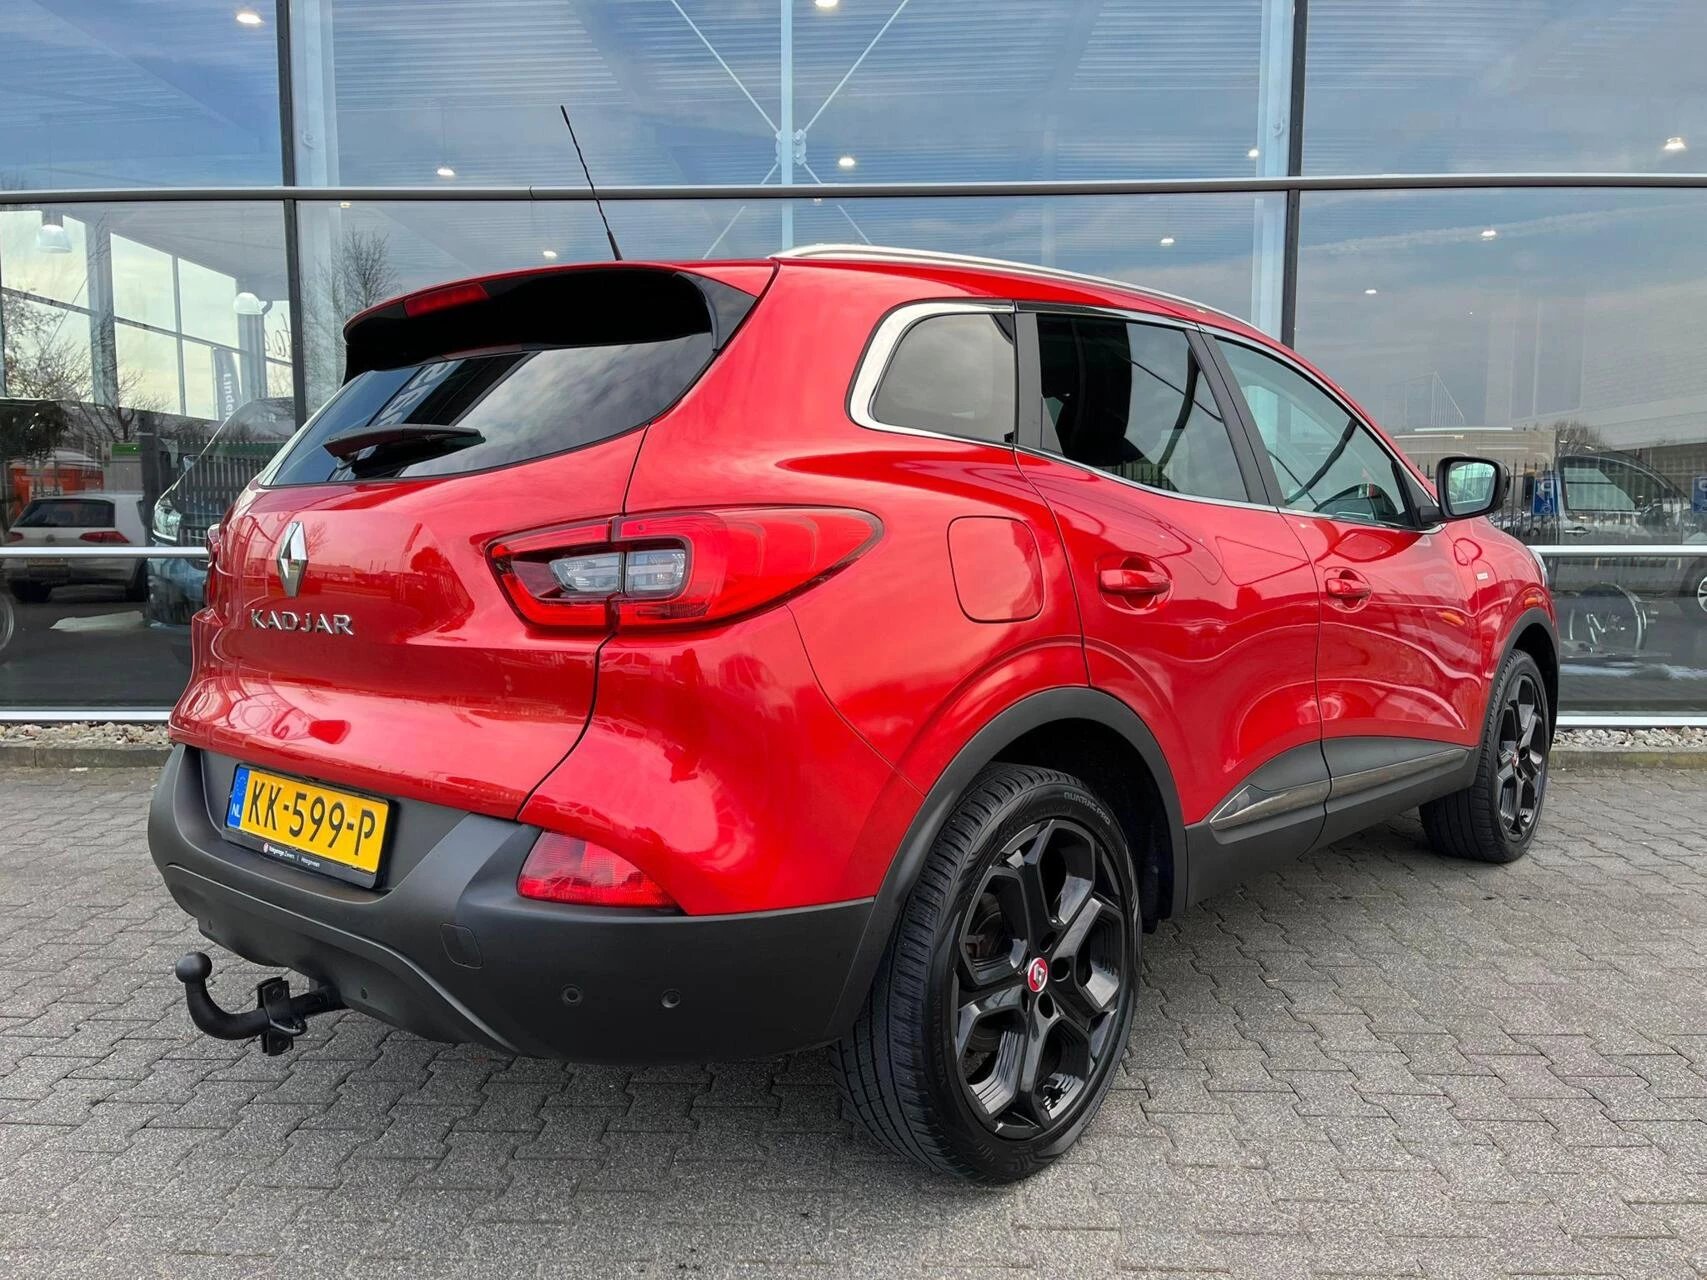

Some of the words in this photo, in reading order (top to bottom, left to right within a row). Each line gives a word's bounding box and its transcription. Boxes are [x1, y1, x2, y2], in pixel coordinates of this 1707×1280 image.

[250, 608, 354, 636] KADJAR
[231, 803, 240, 818] NL
[248, 779, 376, 856] KK-599-P
